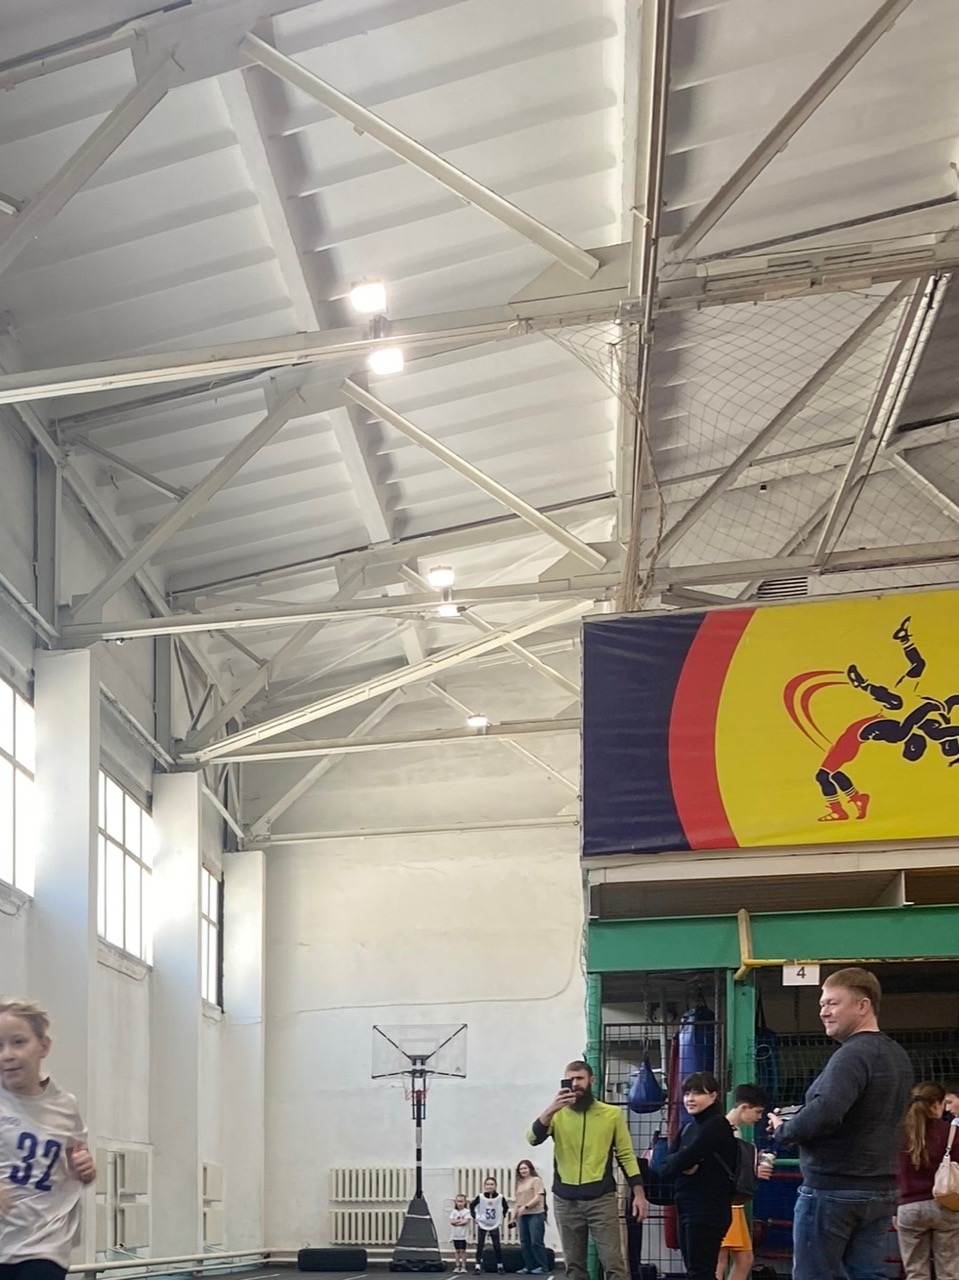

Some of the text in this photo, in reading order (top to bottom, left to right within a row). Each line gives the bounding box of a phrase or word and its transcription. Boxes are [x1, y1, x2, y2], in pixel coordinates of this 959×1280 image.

[796, 966, 806, 979] 4
[10, 1131, 62, 1191] 32
[485, 1208, 496, 1220] 53
